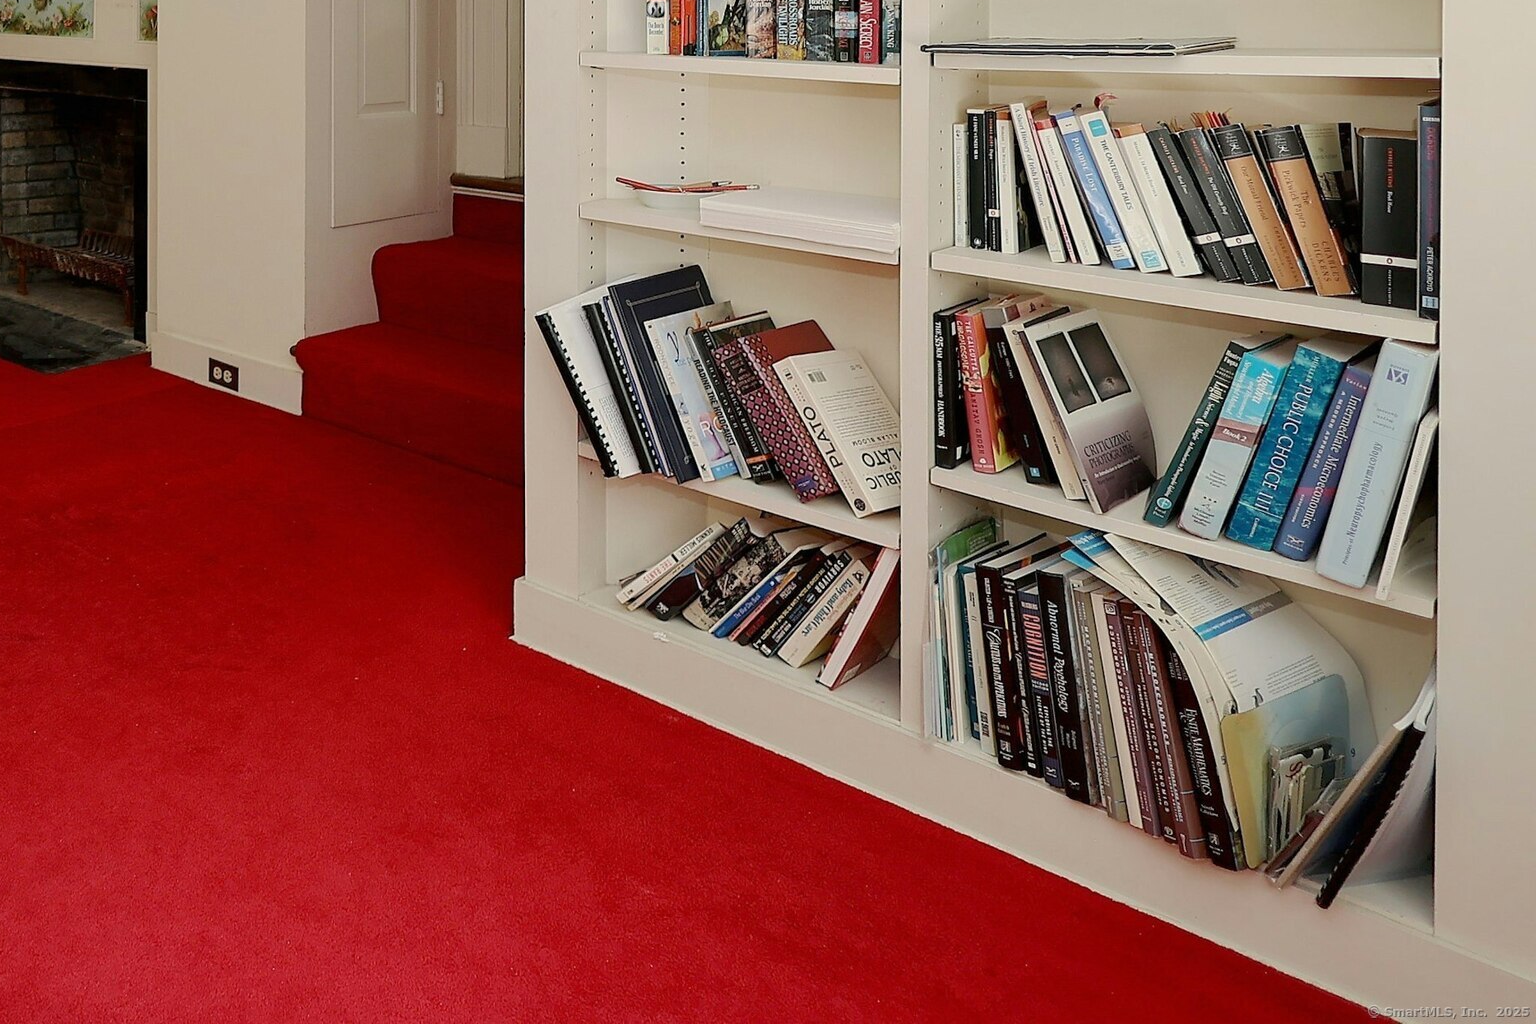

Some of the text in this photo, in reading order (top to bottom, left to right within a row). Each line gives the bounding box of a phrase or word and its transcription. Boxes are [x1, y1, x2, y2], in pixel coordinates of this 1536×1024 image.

[778, 3, 788, 45] TWILIGHT
[859, 18, 877, 51] SECRECY
[1015, 114, 1045, 207] Short History of Irish Literature
[1070, 137, 1099, 193] PARADISE LOST
[1100, 139, 1134, 211] THE CANTERBURY TALES
[1240, 166, 1269, 221] Our Mutual Friend
[1282, 169, 1308, 228] Pickwick Papers
[1300, 190, 1311, 205] The
[1311, 243, 1332, 283] DICKENS
[1424, 246, 1435, 292] PETER ACKROYD
[702, 331, 713, 348] THE
[956, 320, 970, 370] CHROMOSOME
[966, 336, 980, 373] CALCUTTA
[1225, 350, 1242, 362] Hunter
[693, 358, 738, 447] READING THE HOLOCAUST
[1208, 380, 1229, 404] Light
[1252, 367, 1274, 405] Algebra
[1345, 377, 1367, 390] Varian
[723, 380, 761, 454] AMERICAN FREEDOM
[802, 405, 845, 469] PLATO
[851, 432, 899, 447] ALLAN BLOOM
[937, 399, 946, 438] HANDBOOK
[969, 393, 985, 455] AMITAV GHOSH
[1222, 428, 1241, 441] Book
[1311, 398, 1344, 469] MODERN APPROACH
[860, 447, 901, 468] LATO
[1083, 429, 1132, 458] CRITICIZING
[1088, 442, 1135, 469] PHOTOGRAPHS
[1254, 383, 1314, 514] PUBLIC CHOICE III
[1301, 394, 1362, 529] Intermediate Microeconomics
[1346, 442, 1384, 538] Neuropsychopharmacology
[679, 527, 715, 557] DENNIS MILLER
[814, 559, 845, 594] SURVIVOR
[801, 578, 854, 637] Baby and Child Care
[1022, 612, 1050, 680] COGNITION
[1045, 599, 1070, 713] Abnormal Psychology
[1083, 626, 1101, 716] MACROECONOMICS
[1108, 624, 1128, 714] MACROECONOMICS
[1136, 684, 1147, 715] PRINCIPLES
[1148, 652, 1170, 746] MICROECONOMICS
[1148, 722, 1170, 813] MICROECONOMICS
[1184, 707, 1213, 797] FINITE MATHEMATICS
[1185, 740, 1200, 788] Applications
